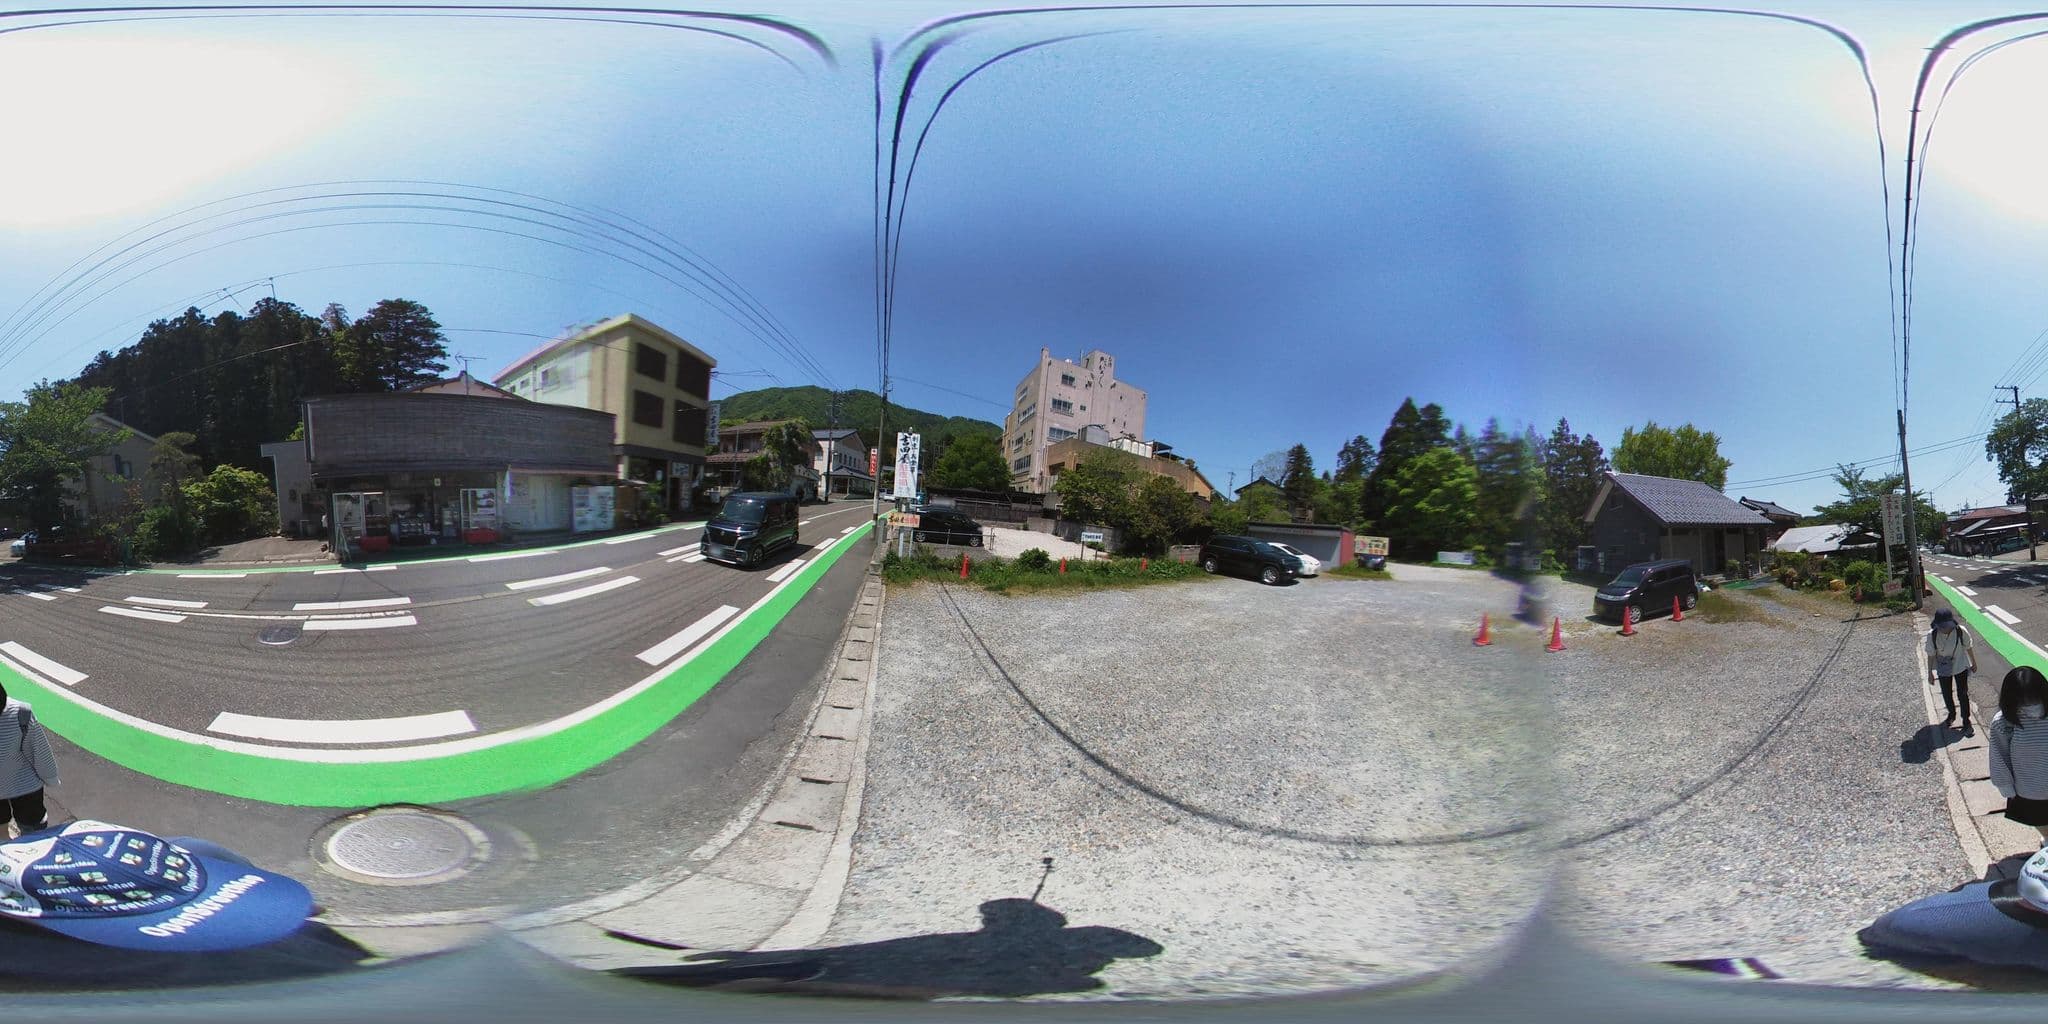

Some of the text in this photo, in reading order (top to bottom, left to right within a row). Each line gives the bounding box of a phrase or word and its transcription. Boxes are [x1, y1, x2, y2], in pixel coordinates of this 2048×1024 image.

[898, 435, 912, 464] 吉田屋
[37, 881, 136, 896] OpenStreetMap
